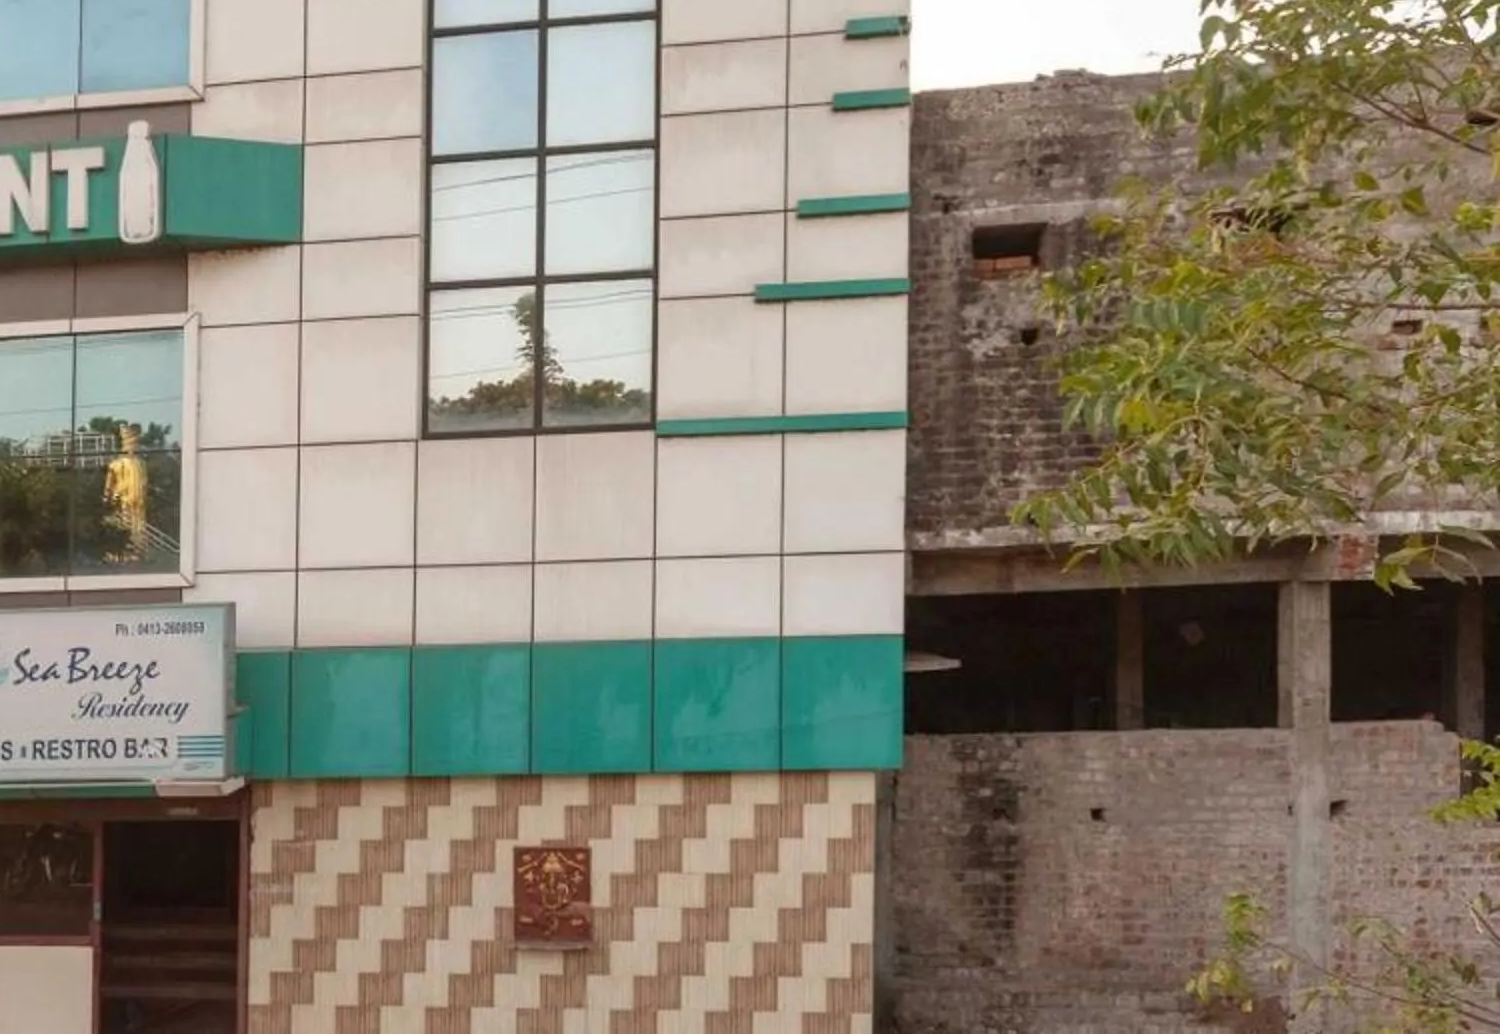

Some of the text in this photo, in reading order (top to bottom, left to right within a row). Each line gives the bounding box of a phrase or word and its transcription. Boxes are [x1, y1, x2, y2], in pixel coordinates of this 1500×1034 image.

[13, 646, 161, 694] Sea Breeze
[71, 692, 190, 723] Residency
[32, 738, 117, 761] RESTRO
